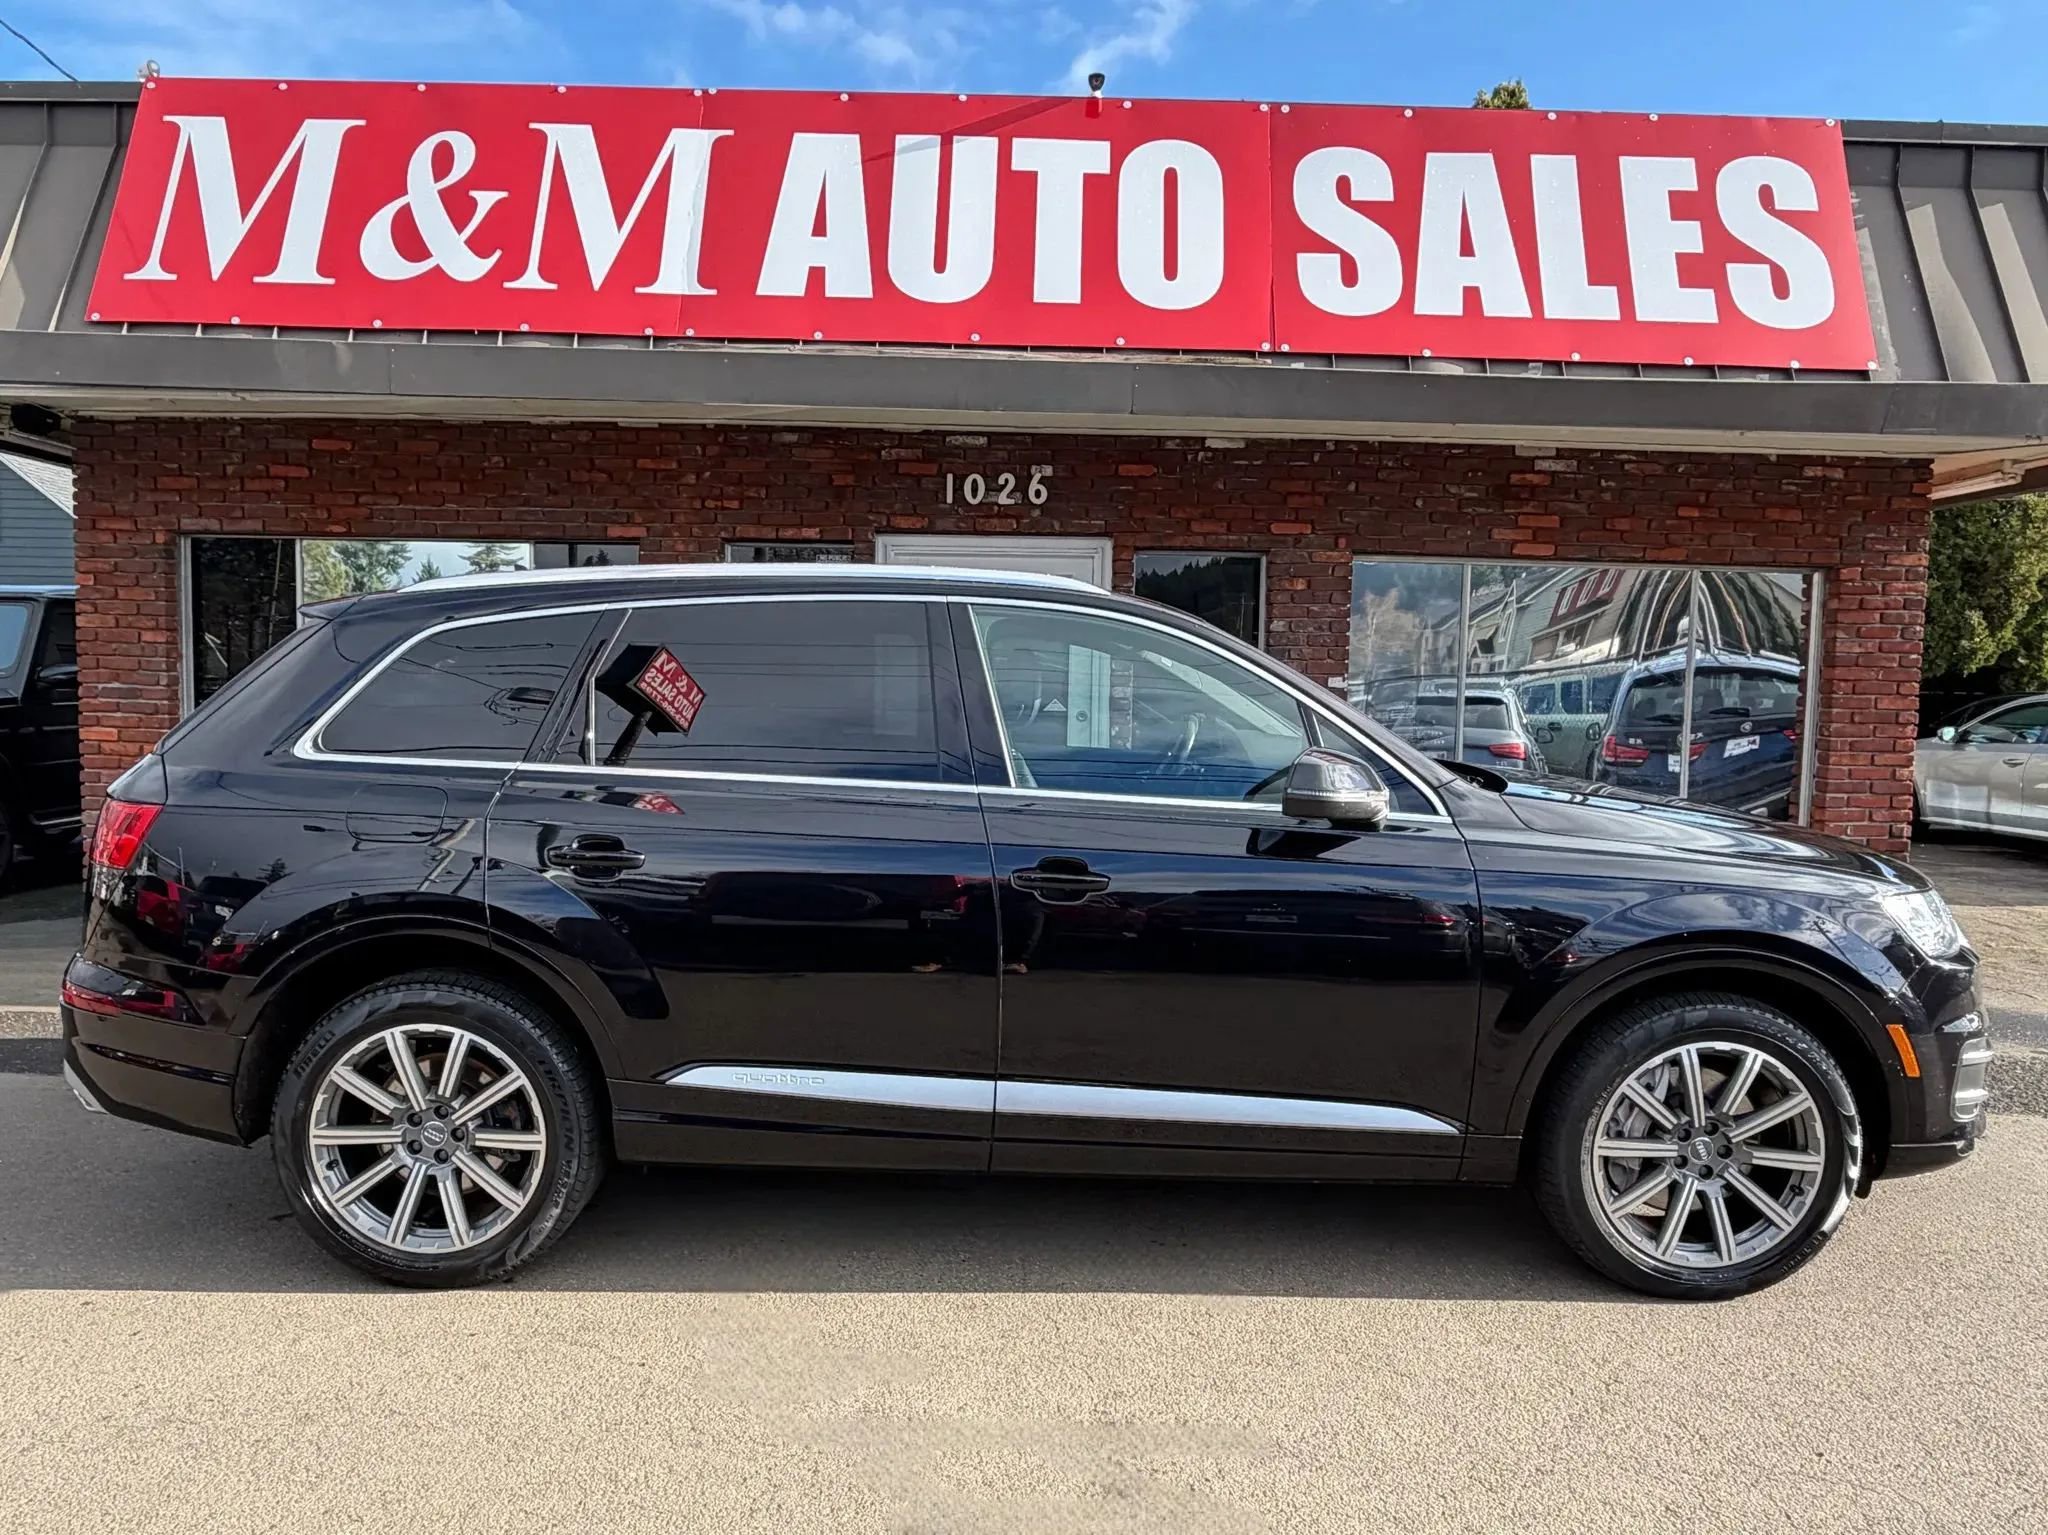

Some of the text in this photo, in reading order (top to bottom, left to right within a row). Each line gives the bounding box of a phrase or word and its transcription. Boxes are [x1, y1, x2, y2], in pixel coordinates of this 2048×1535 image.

[124, 116, 1835, 329] M&M AUTO SALES
[946, 472, 1048, 505] 1026
[732, 1072, 825, 1085] quattro
